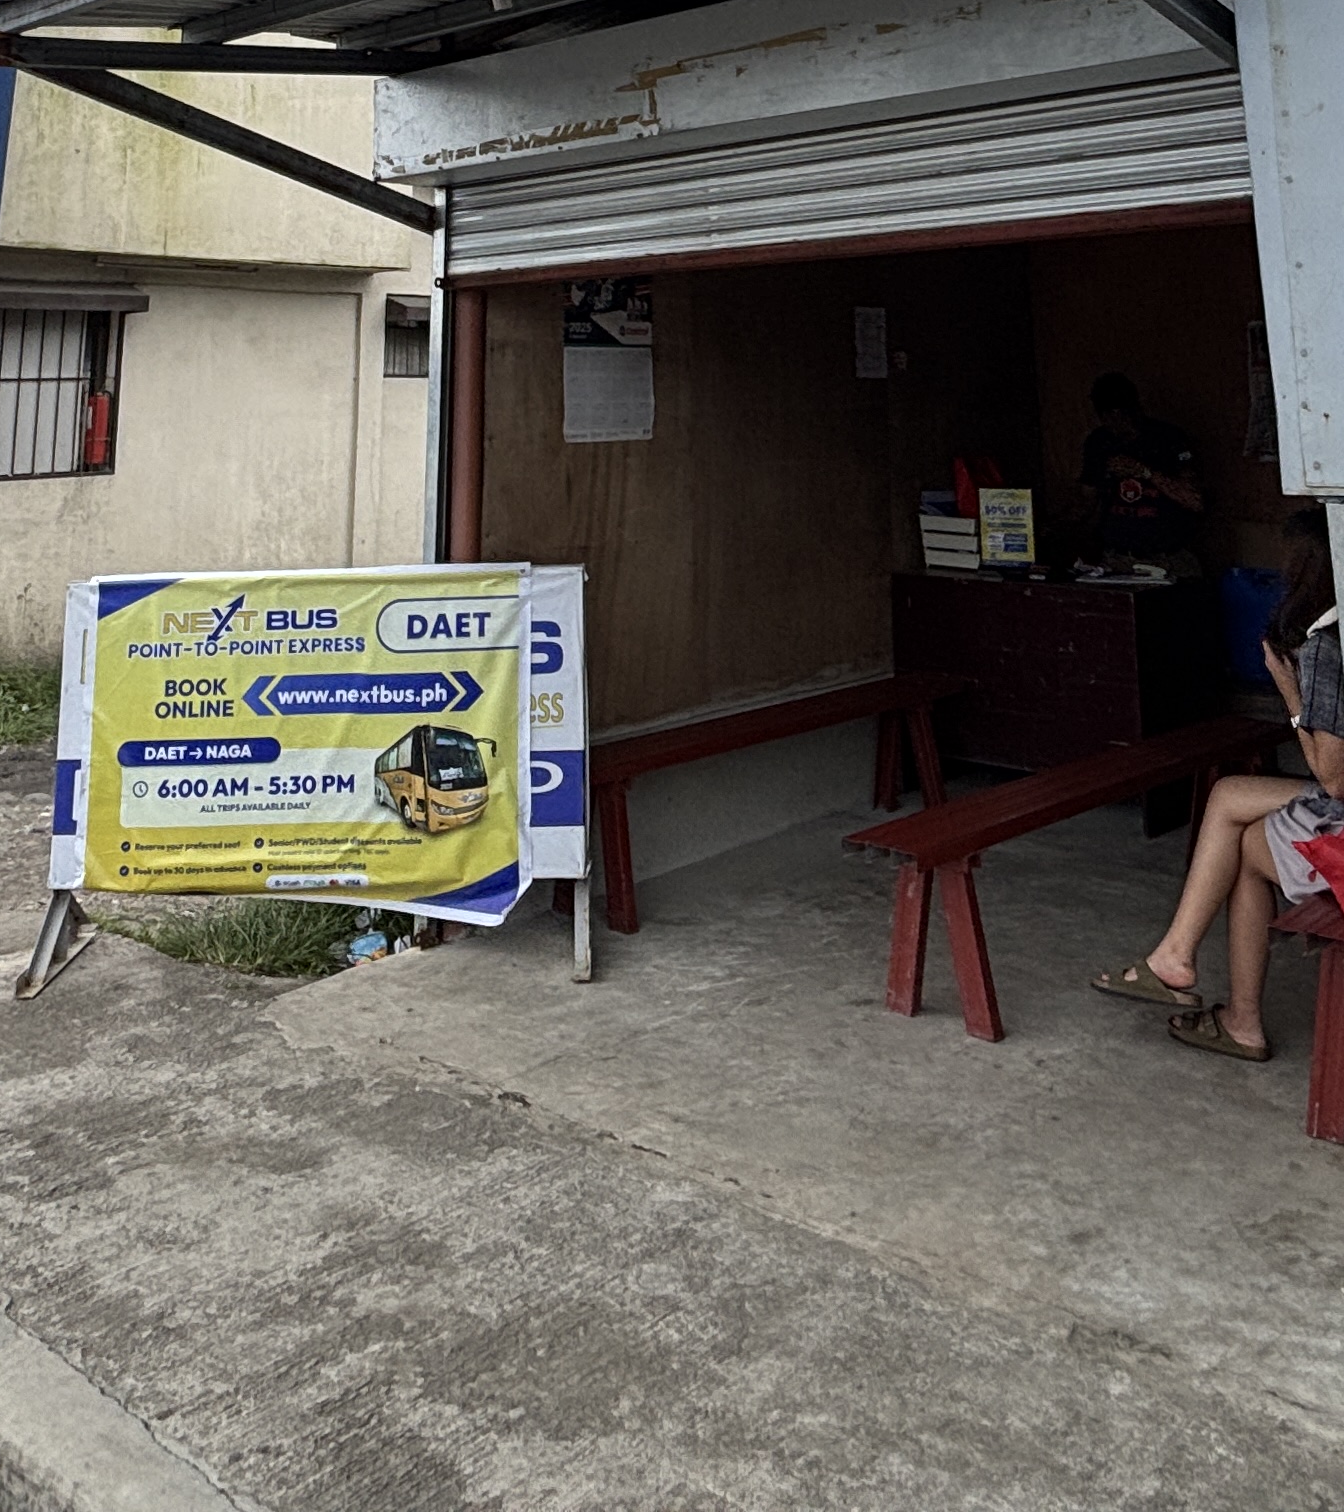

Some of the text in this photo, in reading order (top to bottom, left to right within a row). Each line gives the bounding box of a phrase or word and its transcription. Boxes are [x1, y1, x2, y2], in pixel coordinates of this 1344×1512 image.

[162, 598, 338, 639] NEXT BUS
[406, 611, 492, 640] DAET
[127, 636, 366, 659] POINT-TO-POINT EXPRESS
[164, 678, 228, 697] BOOK
[277, 682, 448, 707] www.nextbus.ph
[154, 699, 235, 719] ONLINE
[143, 744, 253, 761] DAET NAGA
[157, 778, 209, 799] 6:00
[212, 777, 250, 797] AM
[267, 774, 317, 795] 5:30
[321, 773, 356, 794] PM
[199, 801, 312, 814] ALL TRIPS AVAILABLE DAILY
